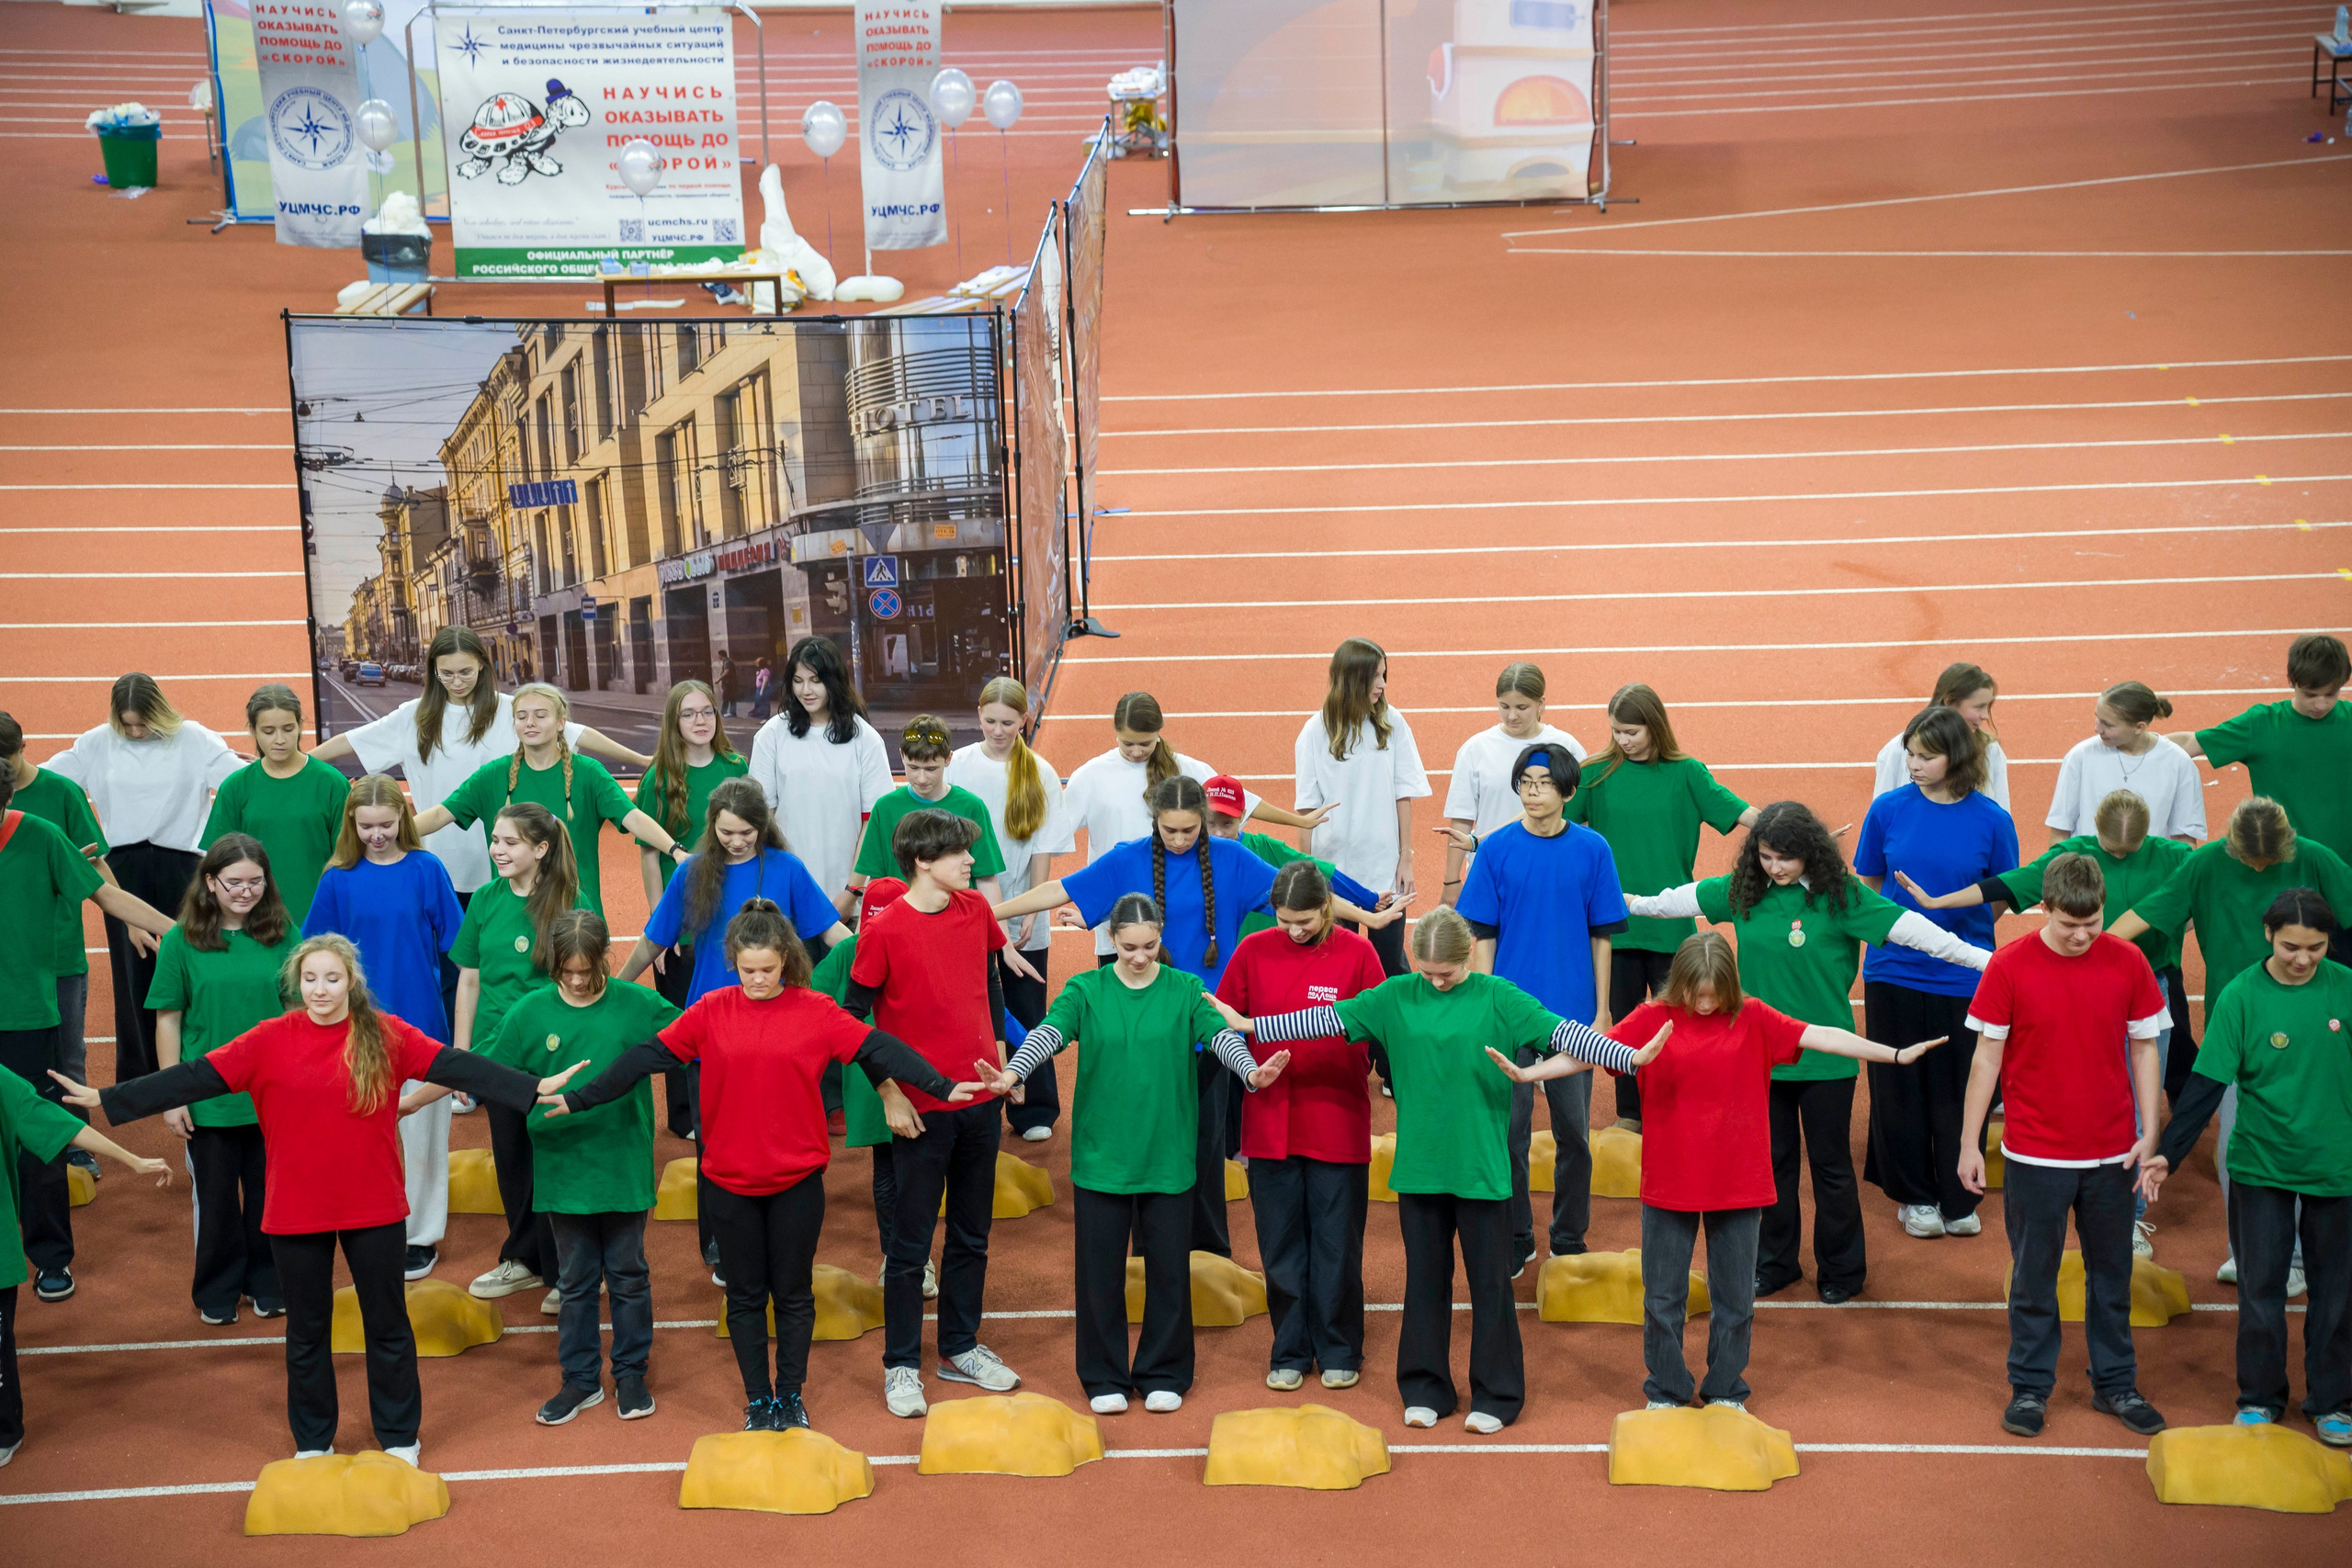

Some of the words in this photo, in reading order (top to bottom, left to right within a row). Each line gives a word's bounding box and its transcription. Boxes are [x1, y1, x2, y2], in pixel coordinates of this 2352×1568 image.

[255, 5, 336, 18] НАУЧИСЬ
[865, 9, 929, 21] НАУЧИСЬ
[257, 20, 338, 35] ОКАЗЫВАТЬ
[497, 25, 629, 36] Санкт-Петербургский
[633, 25, 685, 36] учебный
[689, 26, 724, 36] центр
[865, 25, 929, 37] ОКАЗЫВАТЬ
[259, 36, 321, 50] ПОМОЩЬ
[323, 39, 343, 51] ДО
[499, 42, 565, 51] медицины
[569, 40, 662, 51] чрезвычайных
[666, 39, 724, 51] ситуаций
[866, 41, 913, 52] ПОМОЩЬ
[916, 41, 932, 51] ДО
[261, 52, 345, 67] «СКОРОЙ»
[502, 57, 509, 65] и
[513, 56, 598, 65] безопасности
[603, 55, 724, 65] жизнедеятельности
[603, 85, 722, 100] НАУЧИСЬ
[605, 109, 724, 124] ОКАЗЫВАТЬ
[701, 132, 729, 149] ДО
[609, 153, 731, 170] «РОЙ»
[279, 201, 360, 216] УЦМЧС.РФ
[871, 203, 940, 218] УЦМЧС.РФ
[648, 217, 708, 226] ucmchs.ru
[651, 234, 704, 243] УЦМЧС.РФ
[526, 248, 620, 262] ОФИЦИАЛЬНЫЙ
[622, 247, 674, 260] ПАРТНЁР
[472, 263, 558, 275] РОССИЙСКОГО
[849, 394, 972, 436] HOTEL
[1309, 986, 1338, 994] первая
